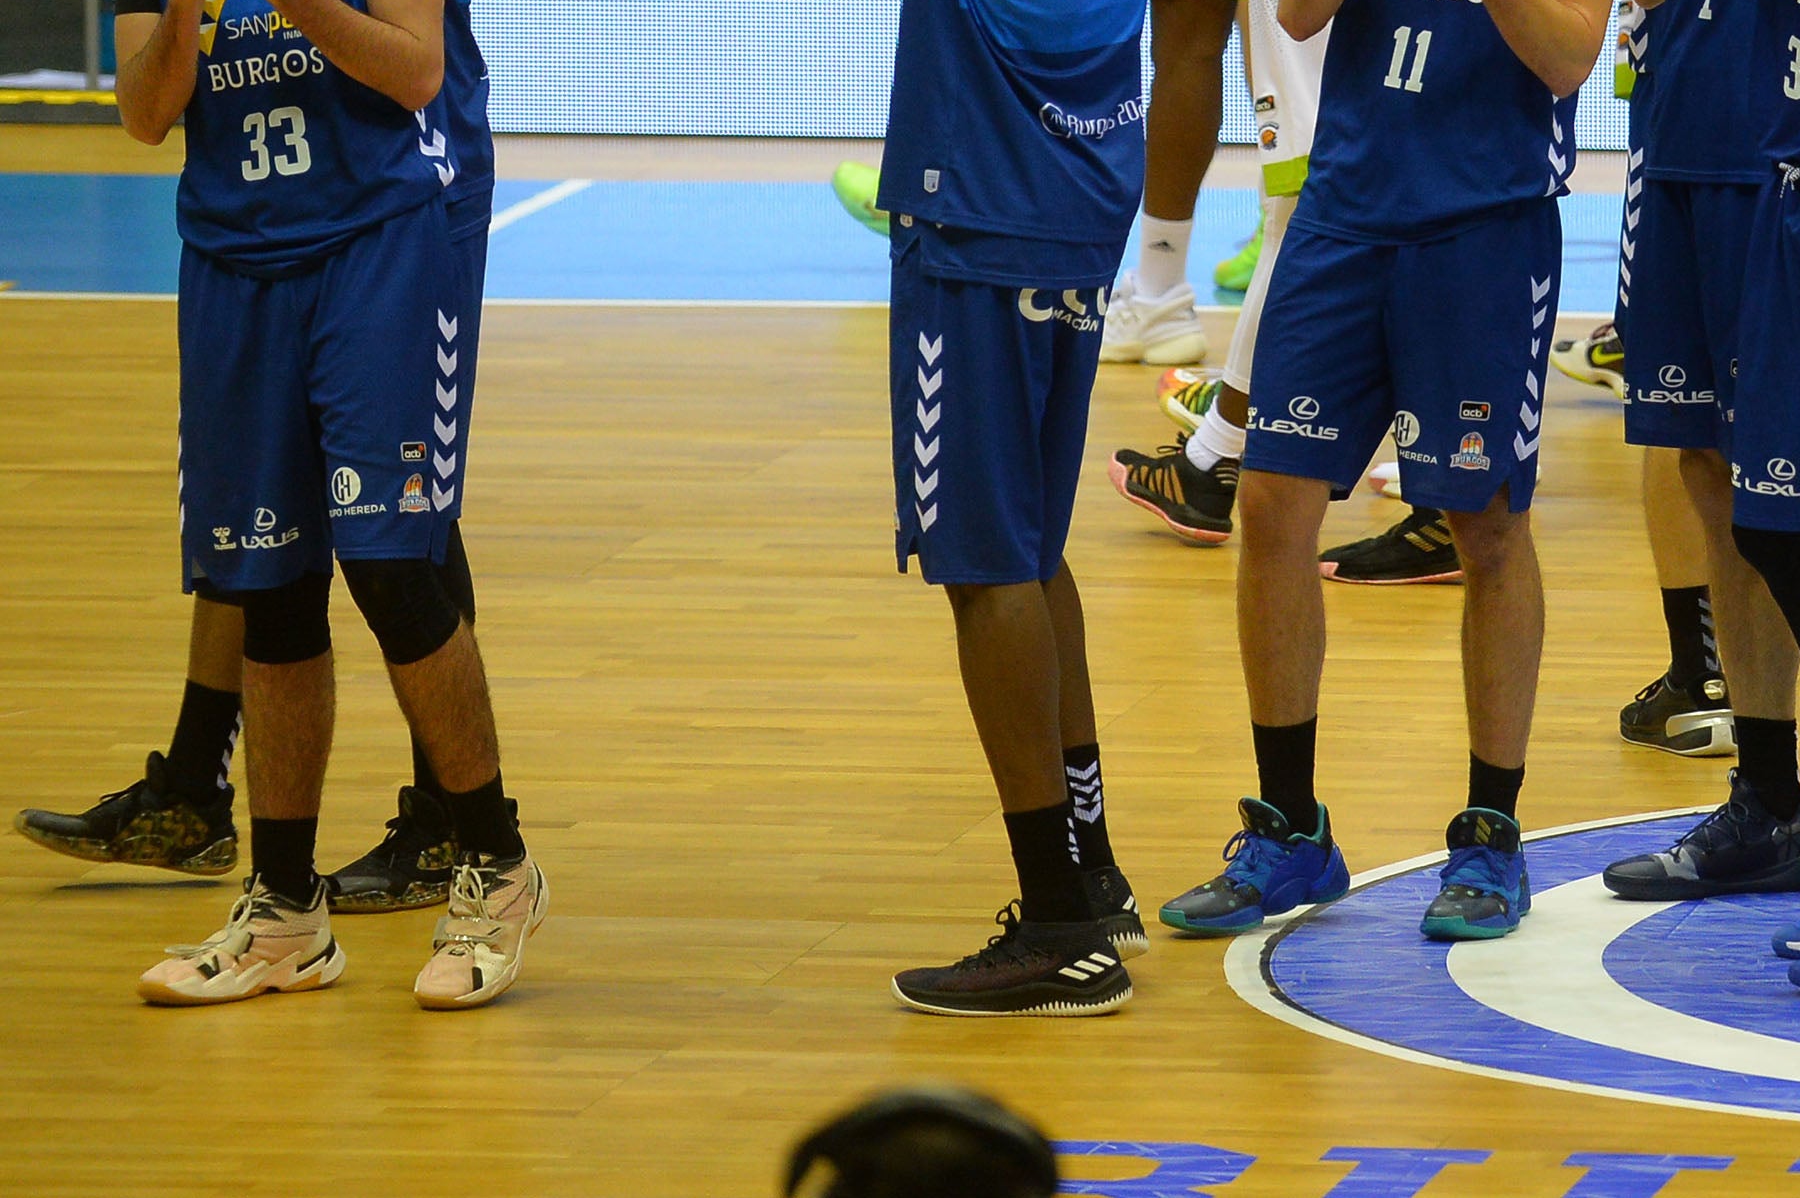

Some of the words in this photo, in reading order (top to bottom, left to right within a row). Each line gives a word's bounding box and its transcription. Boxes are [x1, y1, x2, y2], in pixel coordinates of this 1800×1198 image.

[208, 46, 324, 92] BURGOS
[1384, 26, 1432, 92] 11
[241, 106, 312, 182] 33
[1637, 389, 1715, 404] LEXUS
[1258, 417, 1340, 441] LEXUS
[344, 504, 388, 516] HEREDA
